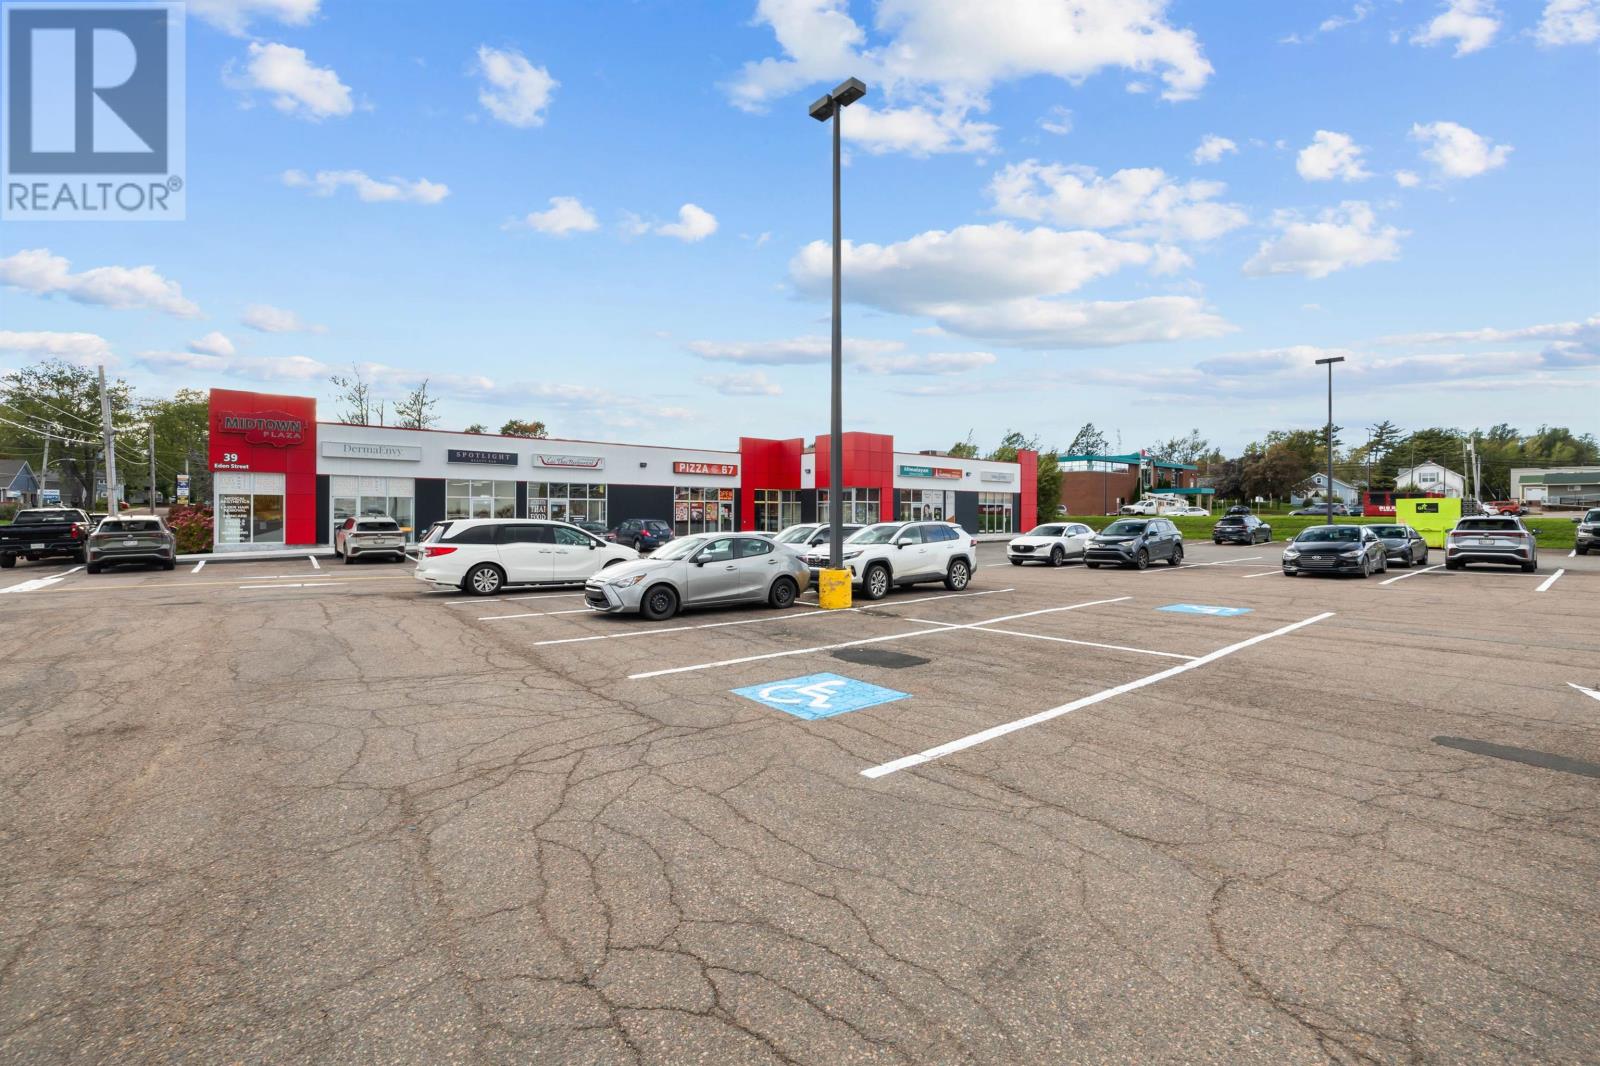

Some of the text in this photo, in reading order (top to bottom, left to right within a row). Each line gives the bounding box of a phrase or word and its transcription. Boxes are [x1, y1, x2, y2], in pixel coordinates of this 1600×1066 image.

[224, 416, 302, 432] MIDTOWN
[263, 431, 301, 439] PLAZA
[343, 444, 402, 456] DermaEnvy
[223, 453, 238, 462] 39
[456, 451, 511, 460] SPOTLIGHT
[679, 463, 709, 474] PIZZA
